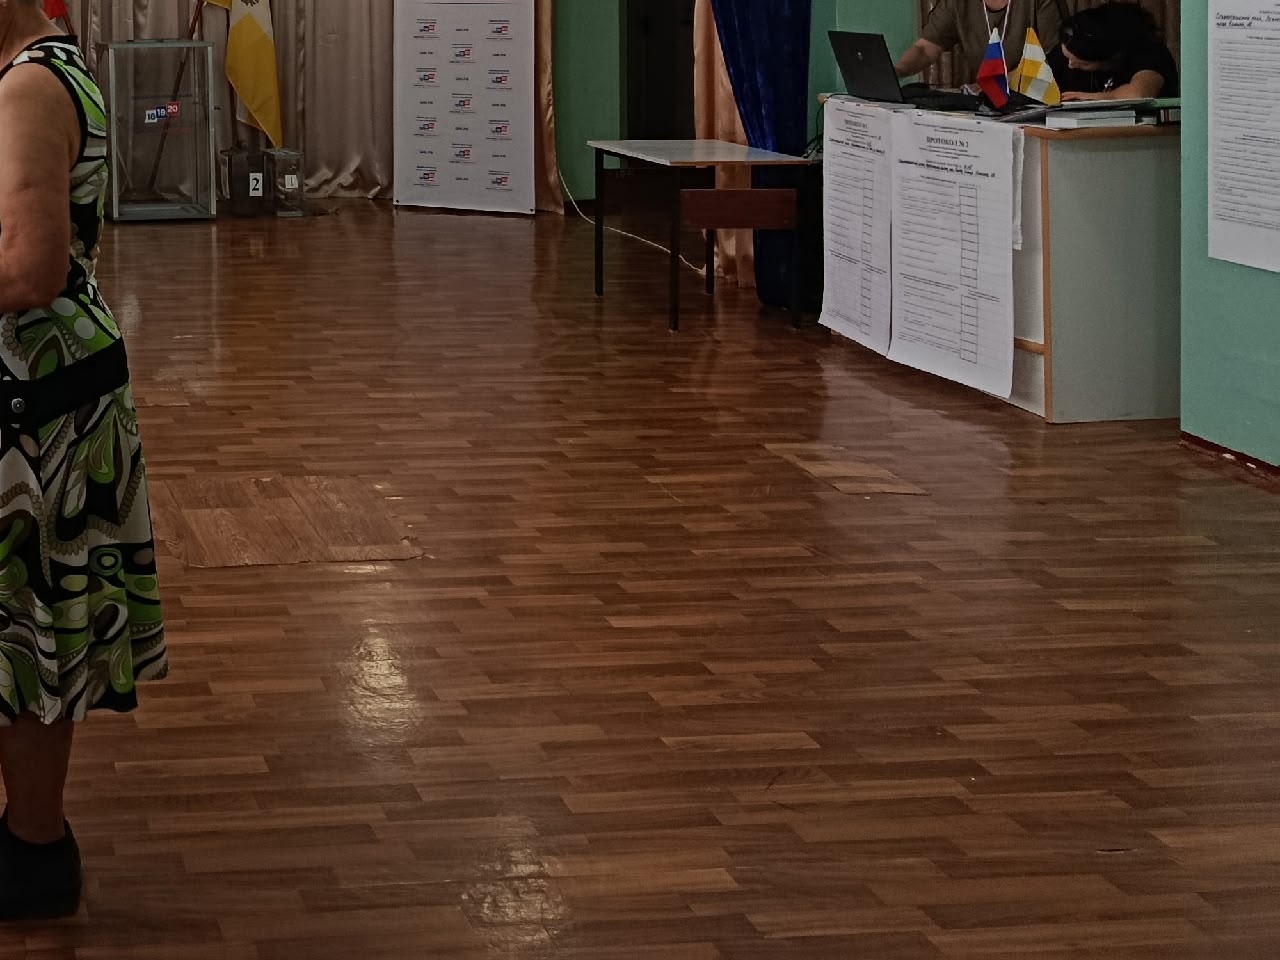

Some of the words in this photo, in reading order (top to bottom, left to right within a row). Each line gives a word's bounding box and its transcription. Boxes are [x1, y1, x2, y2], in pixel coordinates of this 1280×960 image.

[147, 112, 156, 121] 18
[156, 108, 166, 117] 19
[167, 105, 178, 113] 20
[251, 177, 260, 192] 2
